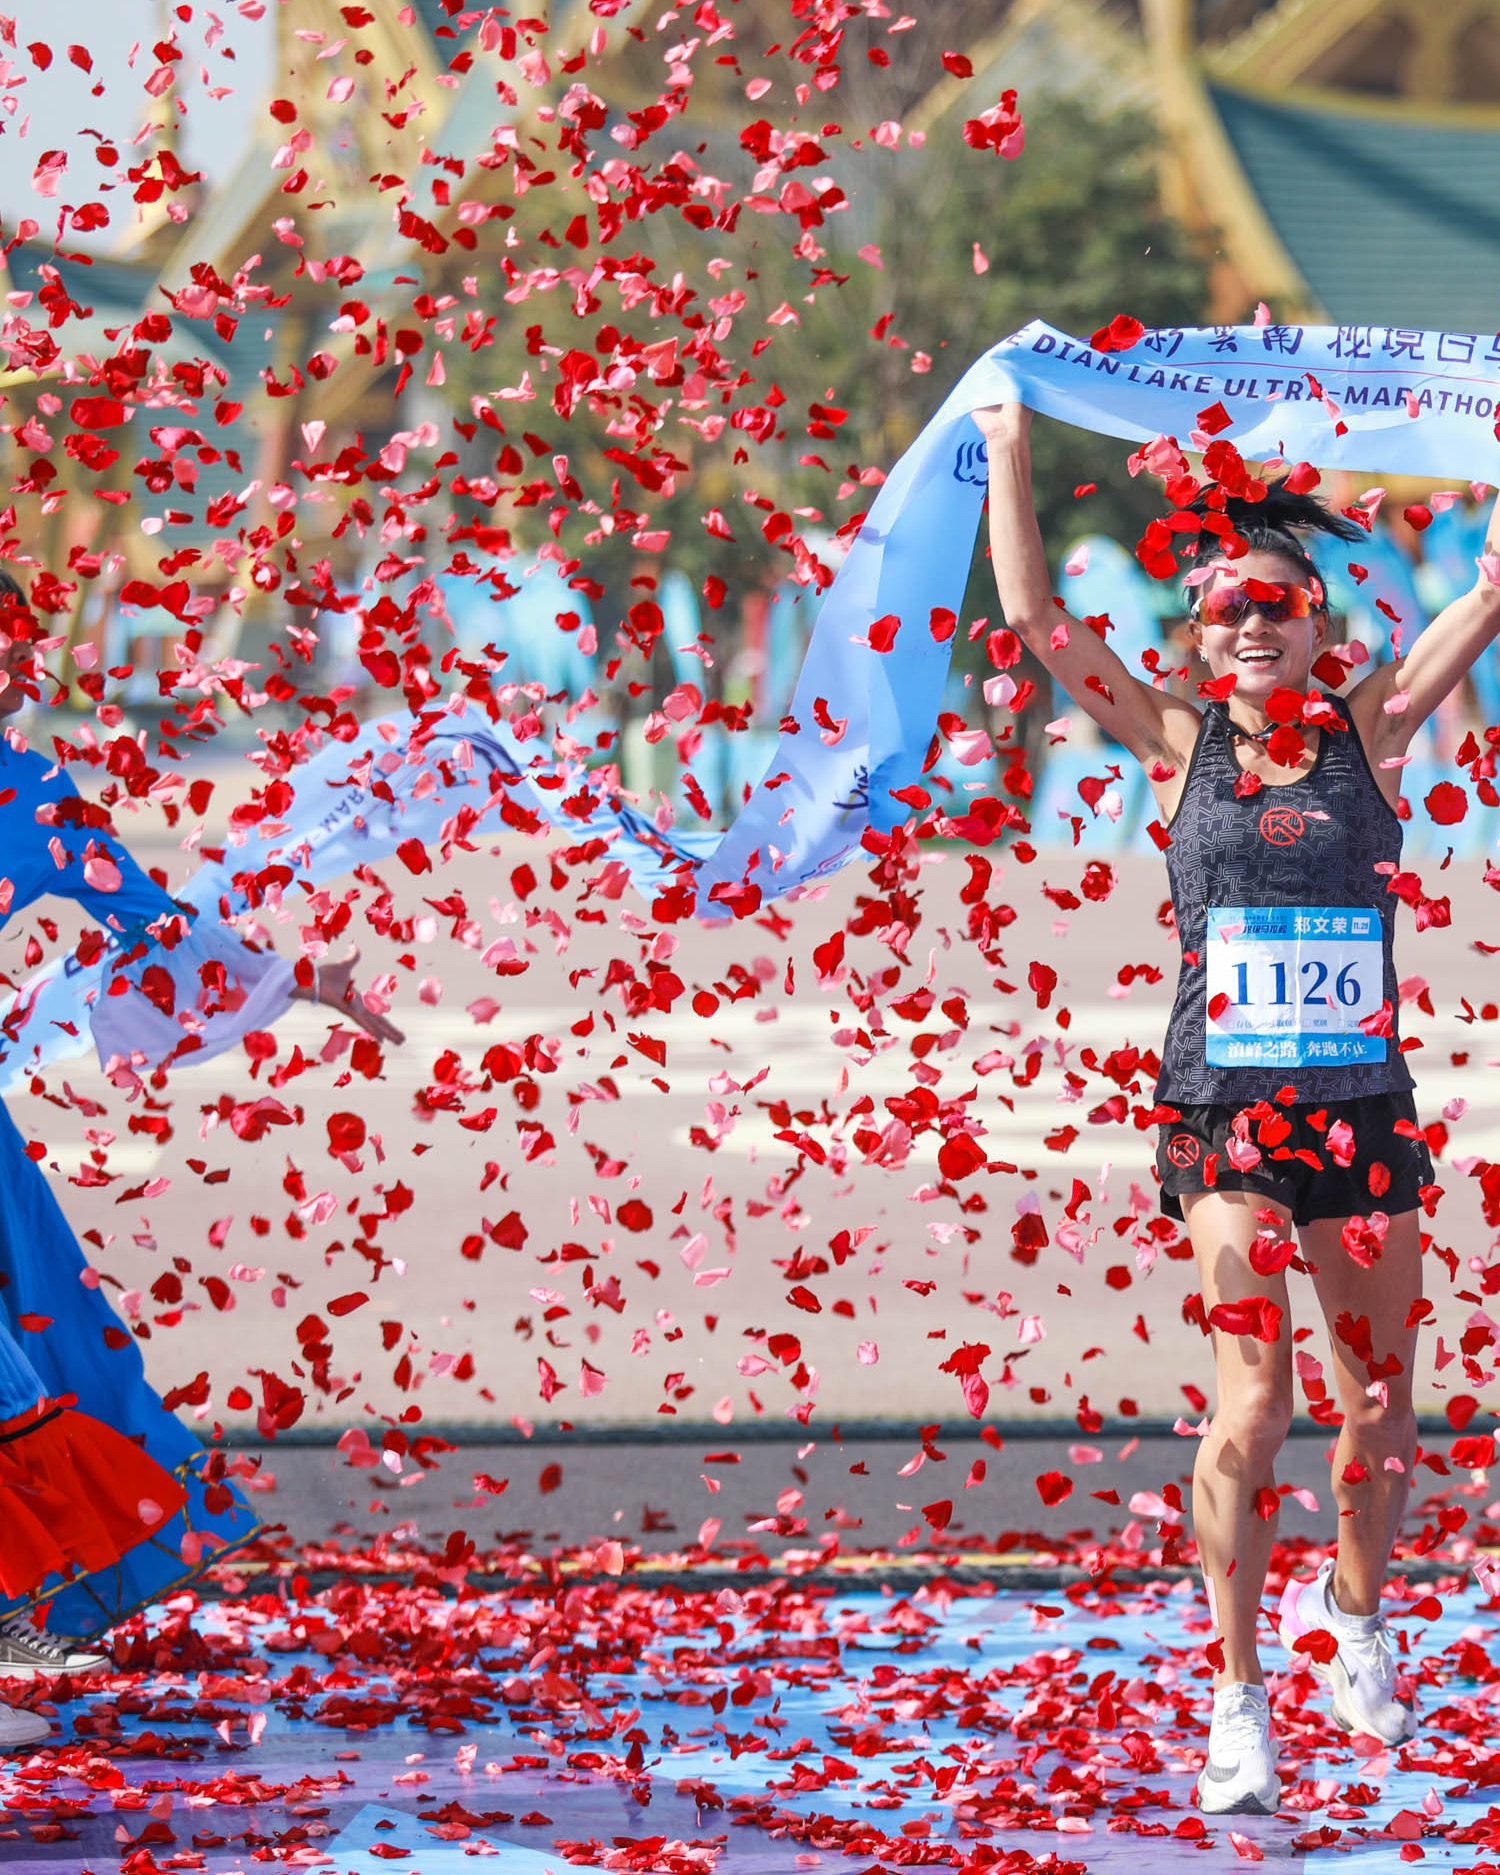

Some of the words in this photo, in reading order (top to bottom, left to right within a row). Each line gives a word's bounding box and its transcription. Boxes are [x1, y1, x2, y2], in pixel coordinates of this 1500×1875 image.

[1031, 333, 1122, 376] DIAN
[1127, 364, 1214, 395] LAKE
[1294, 915, 1348, 935] 郑文荣
[1230, 961, 1361, 1006] 1126
[1306, 1041, 1368, 1058] 奔跑不止
